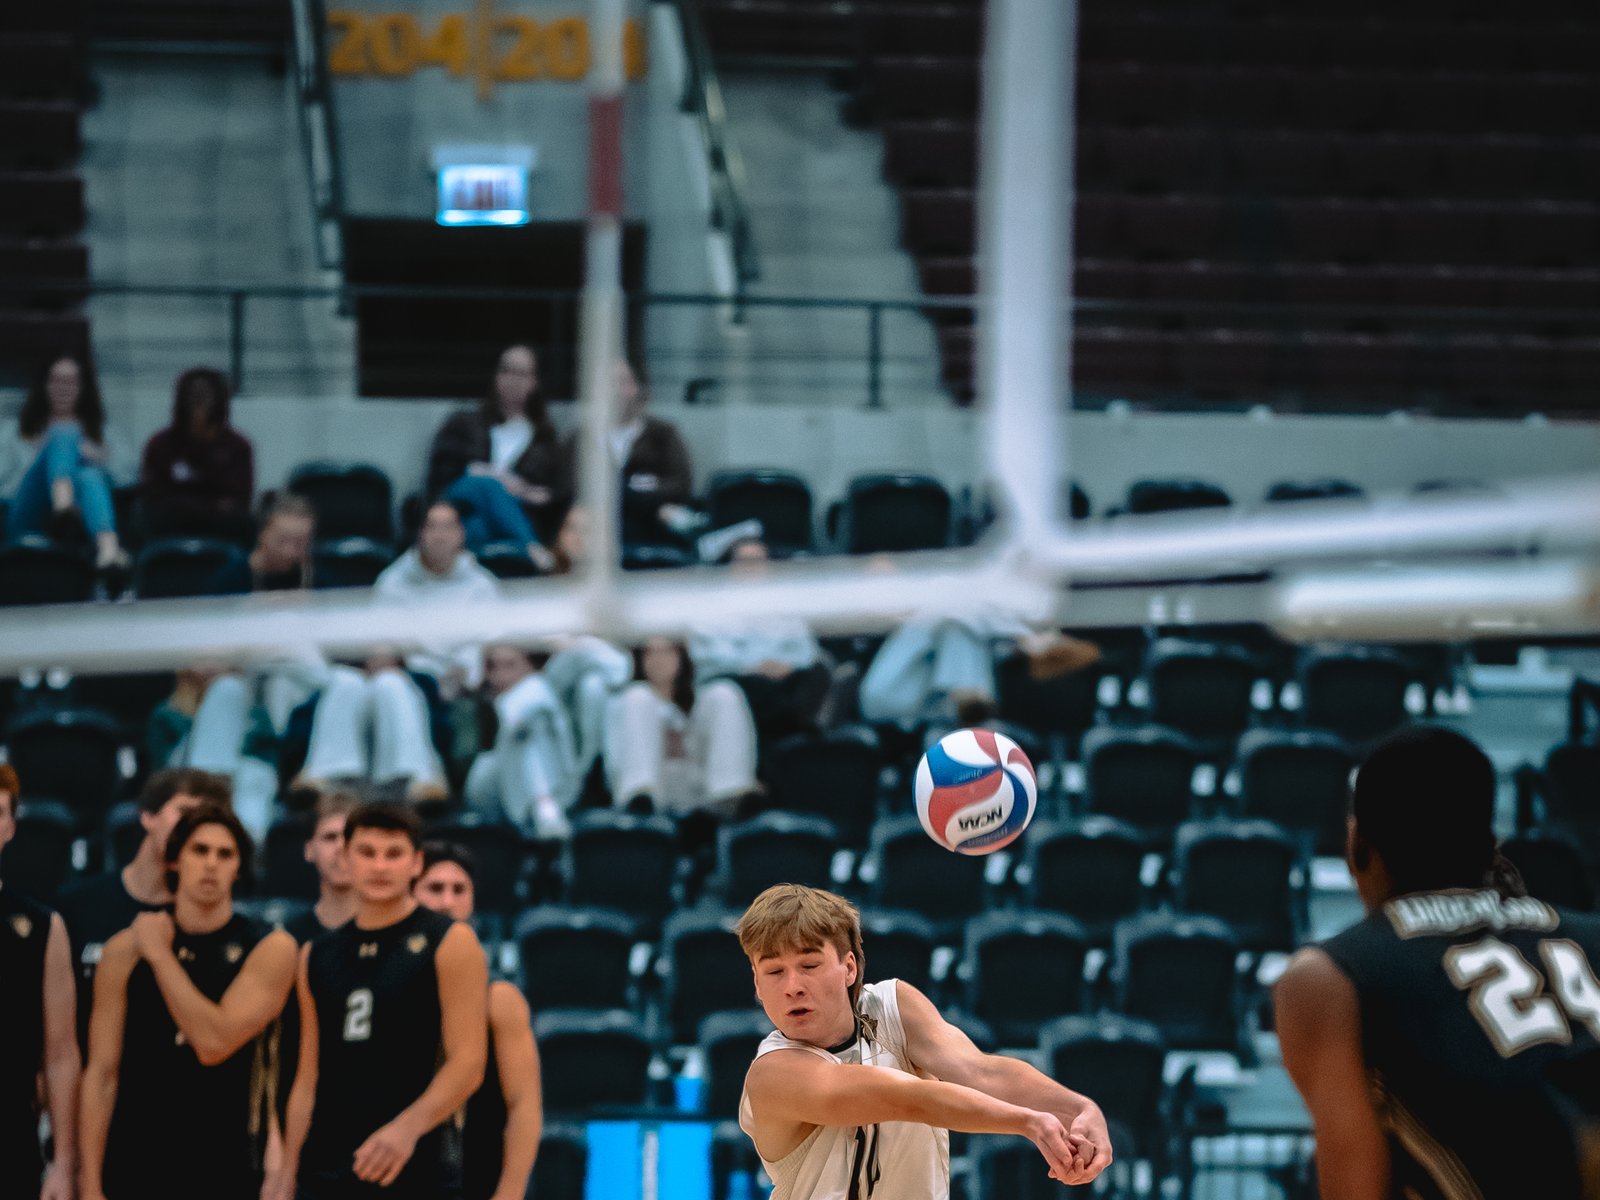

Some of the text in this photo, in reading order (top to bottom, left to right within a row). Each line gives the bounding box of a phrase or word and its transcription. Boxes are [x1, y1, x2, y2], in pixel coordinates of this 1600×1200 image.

[326, 12, 470, 76] 204
[959, 806, 1002, 830] NCAA
[343, 987, 374, 1041] 2
[1443, 935, 1600, 1058] 24
